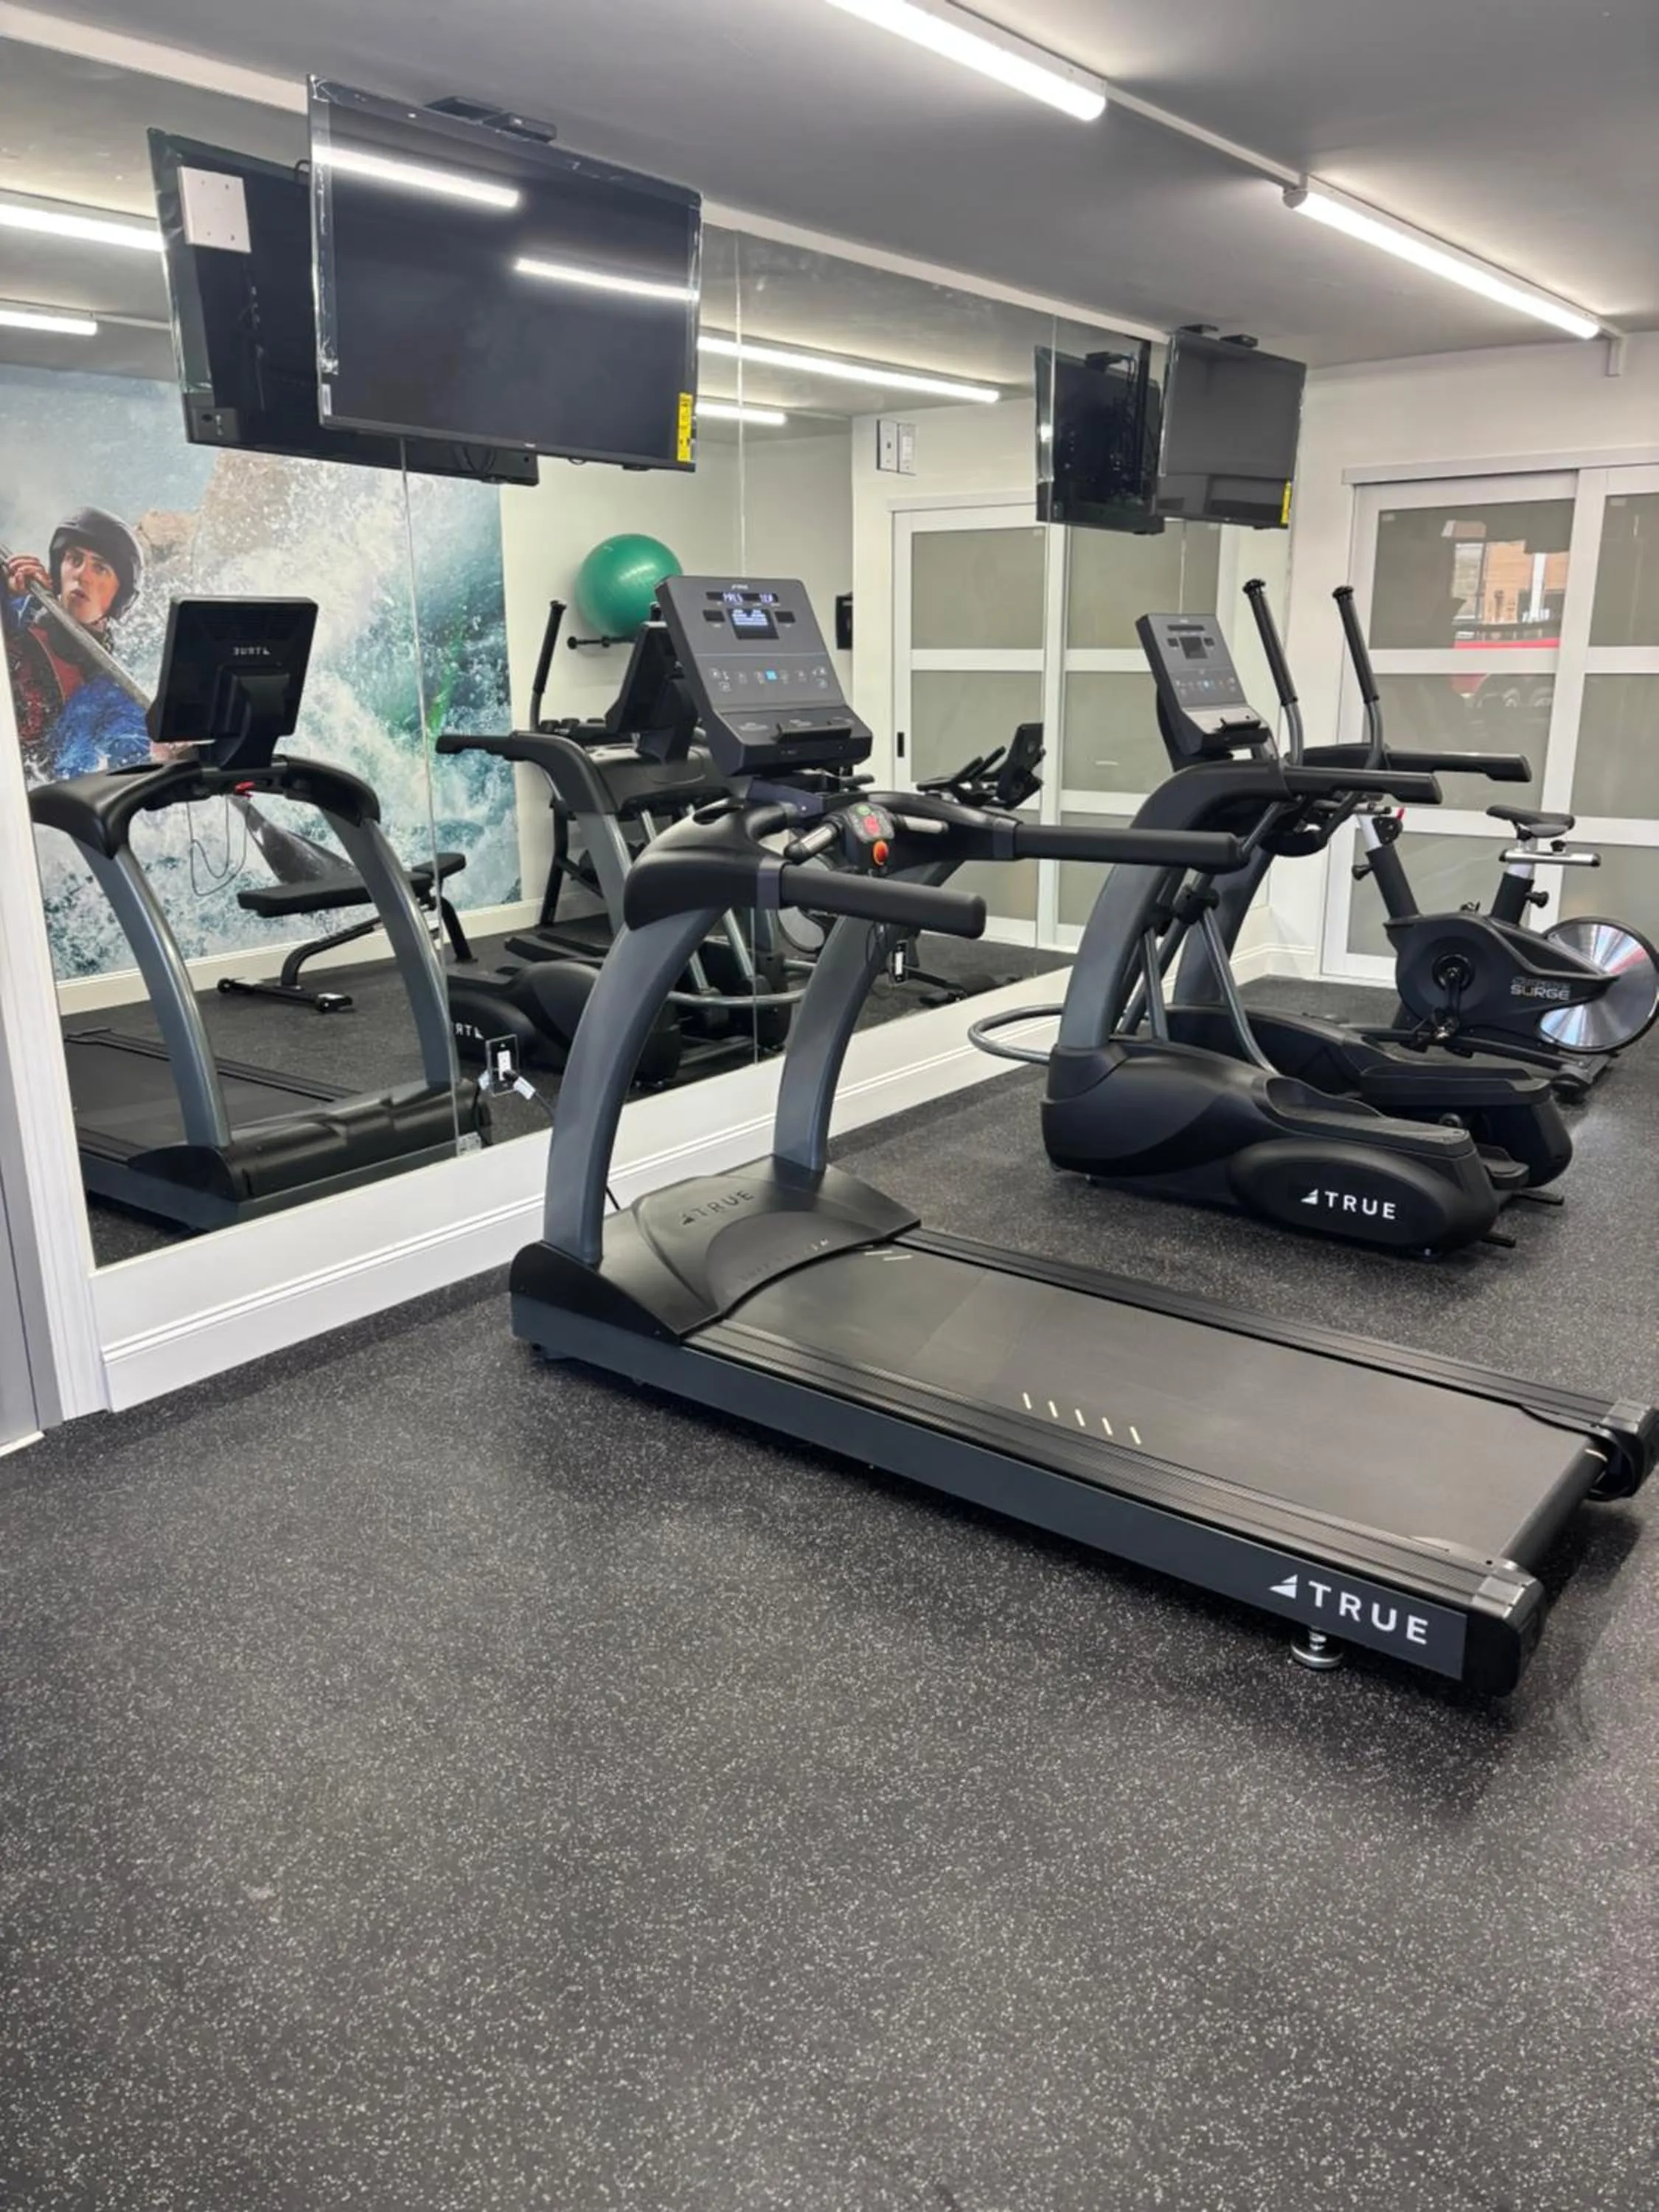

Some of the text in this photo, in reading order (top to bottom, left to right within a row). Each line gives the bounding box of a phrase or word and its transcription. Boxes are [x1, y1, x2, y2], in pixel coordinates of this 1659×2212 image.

[1510, 984, 1571, 1001] SURGE
[691, 1189, 755, 1216] TRUE
[1324, 1191, 1397, 1220] TRUE
[1308, 1580, 1429, 1645] TRUE
